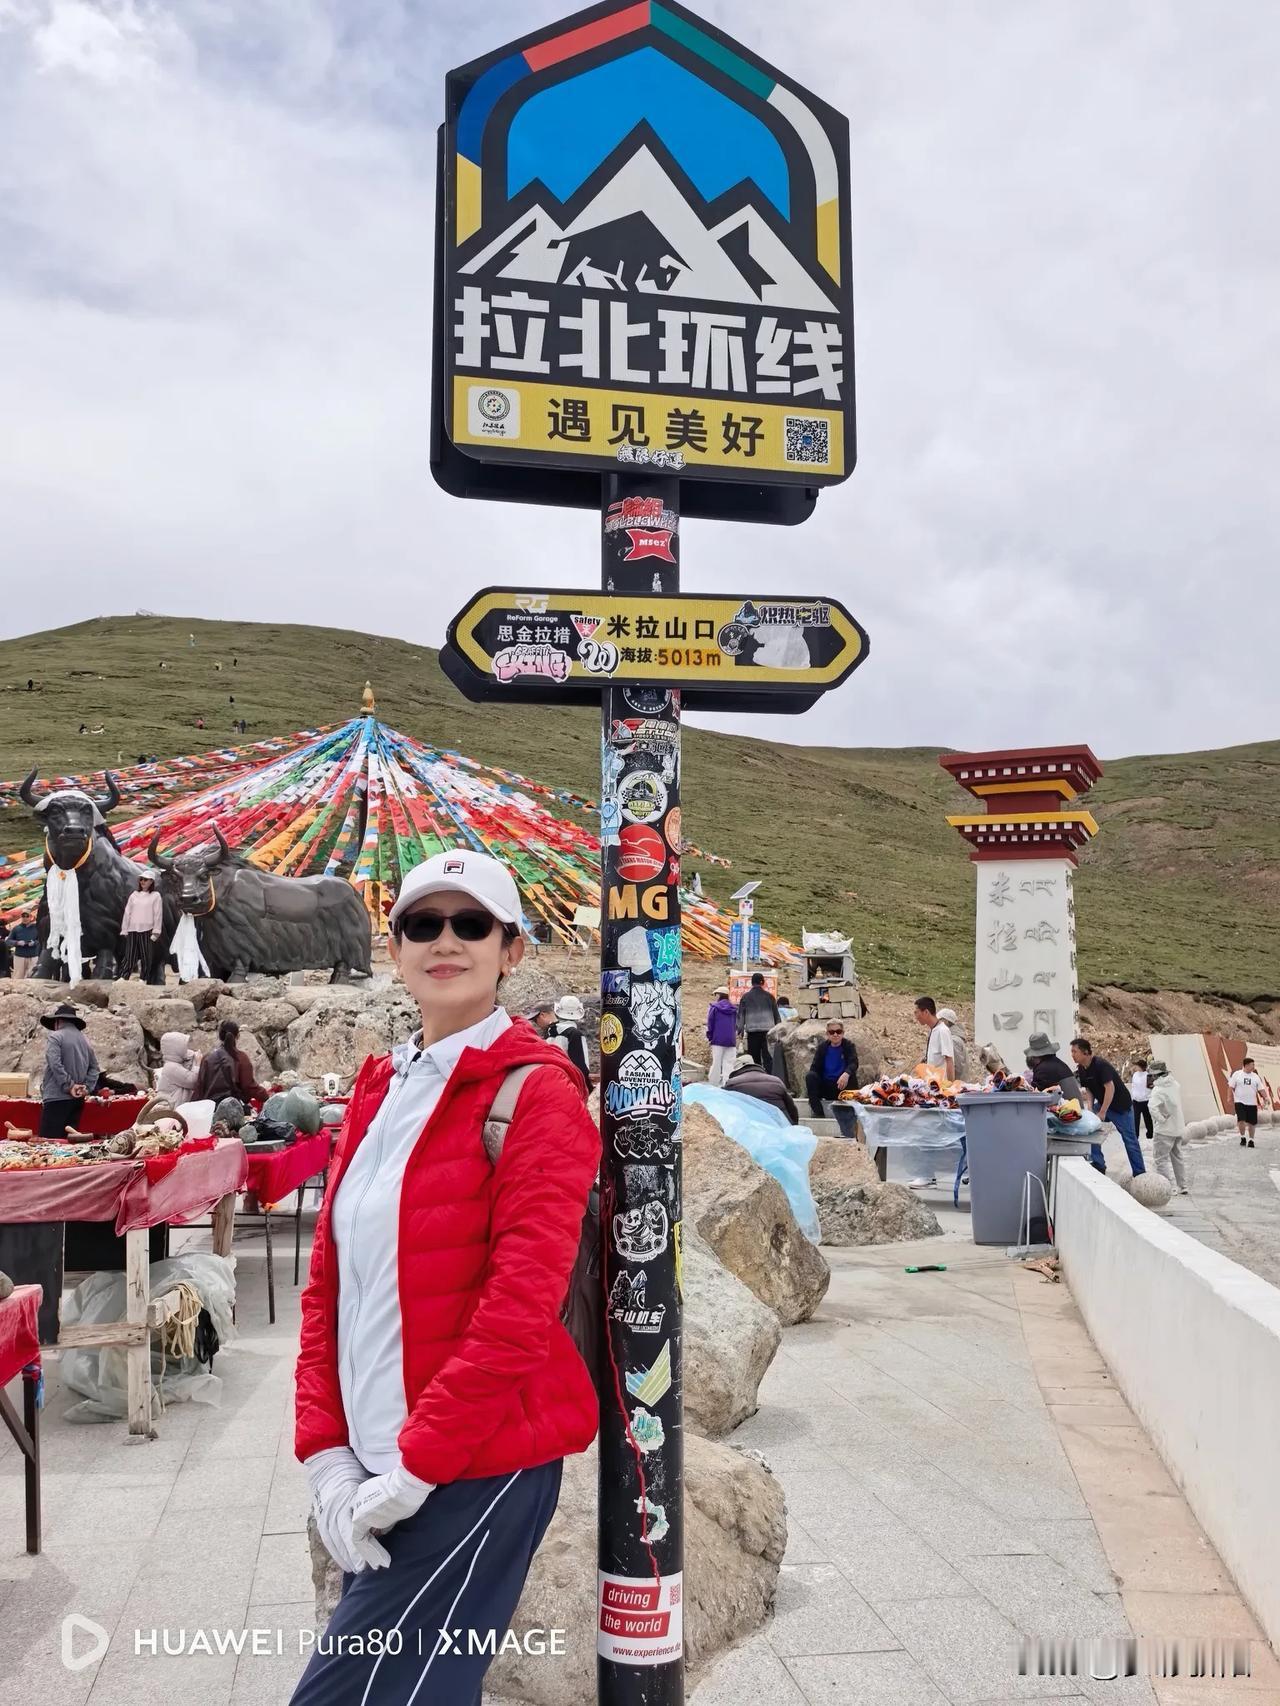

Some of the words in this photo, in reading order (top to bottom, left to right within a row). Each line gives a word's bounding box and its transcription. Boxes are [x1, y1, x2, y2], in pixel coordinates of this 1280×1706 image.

[454, 286, 842, 401] 拉北环线
[547, 398, 765, 455] 遇见美好
[534, 615, 558, 623] Garage
[607, 614, 714, 640] 米拉山口
[497, 625, 571, 644] 思金拉措
[608, 884, 668, 920] MG
[608, 1588, 651, 1608] driving
[604, 1614, 621, 1630] the
[625, 1618, 662, 1633] world
